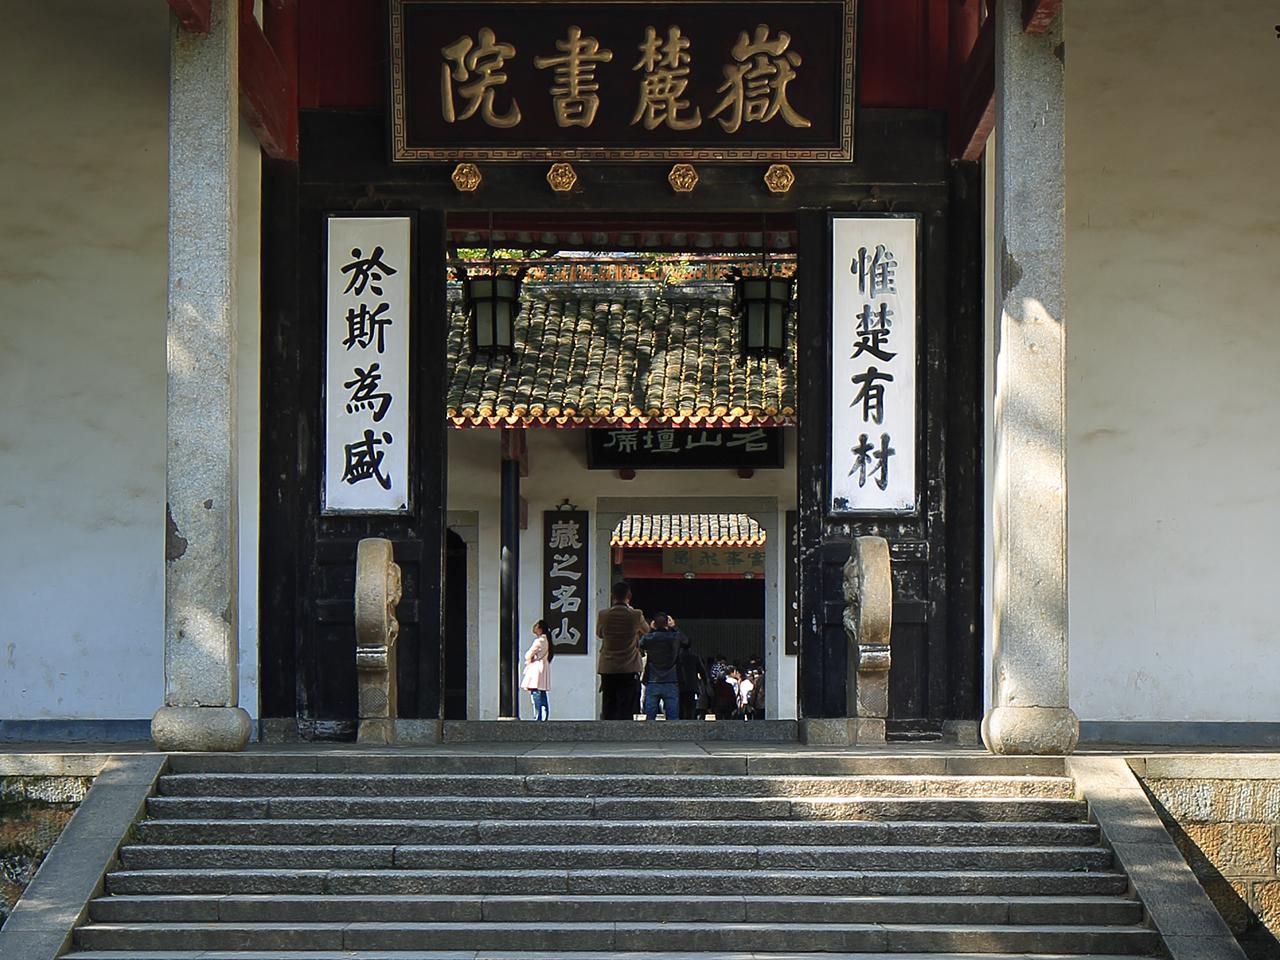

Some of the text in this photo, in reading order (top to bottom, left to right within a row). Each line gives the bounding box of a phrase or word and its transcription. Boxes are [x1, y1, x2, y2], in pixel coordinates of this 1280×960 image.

[440, 23, 812, 135] 嶽麓書院
[340, 246, 398, 490] 於斯為盛
[847, 243, 899, 492] 惟楚有材
[548, 519, 584, 647] 藏之名山
